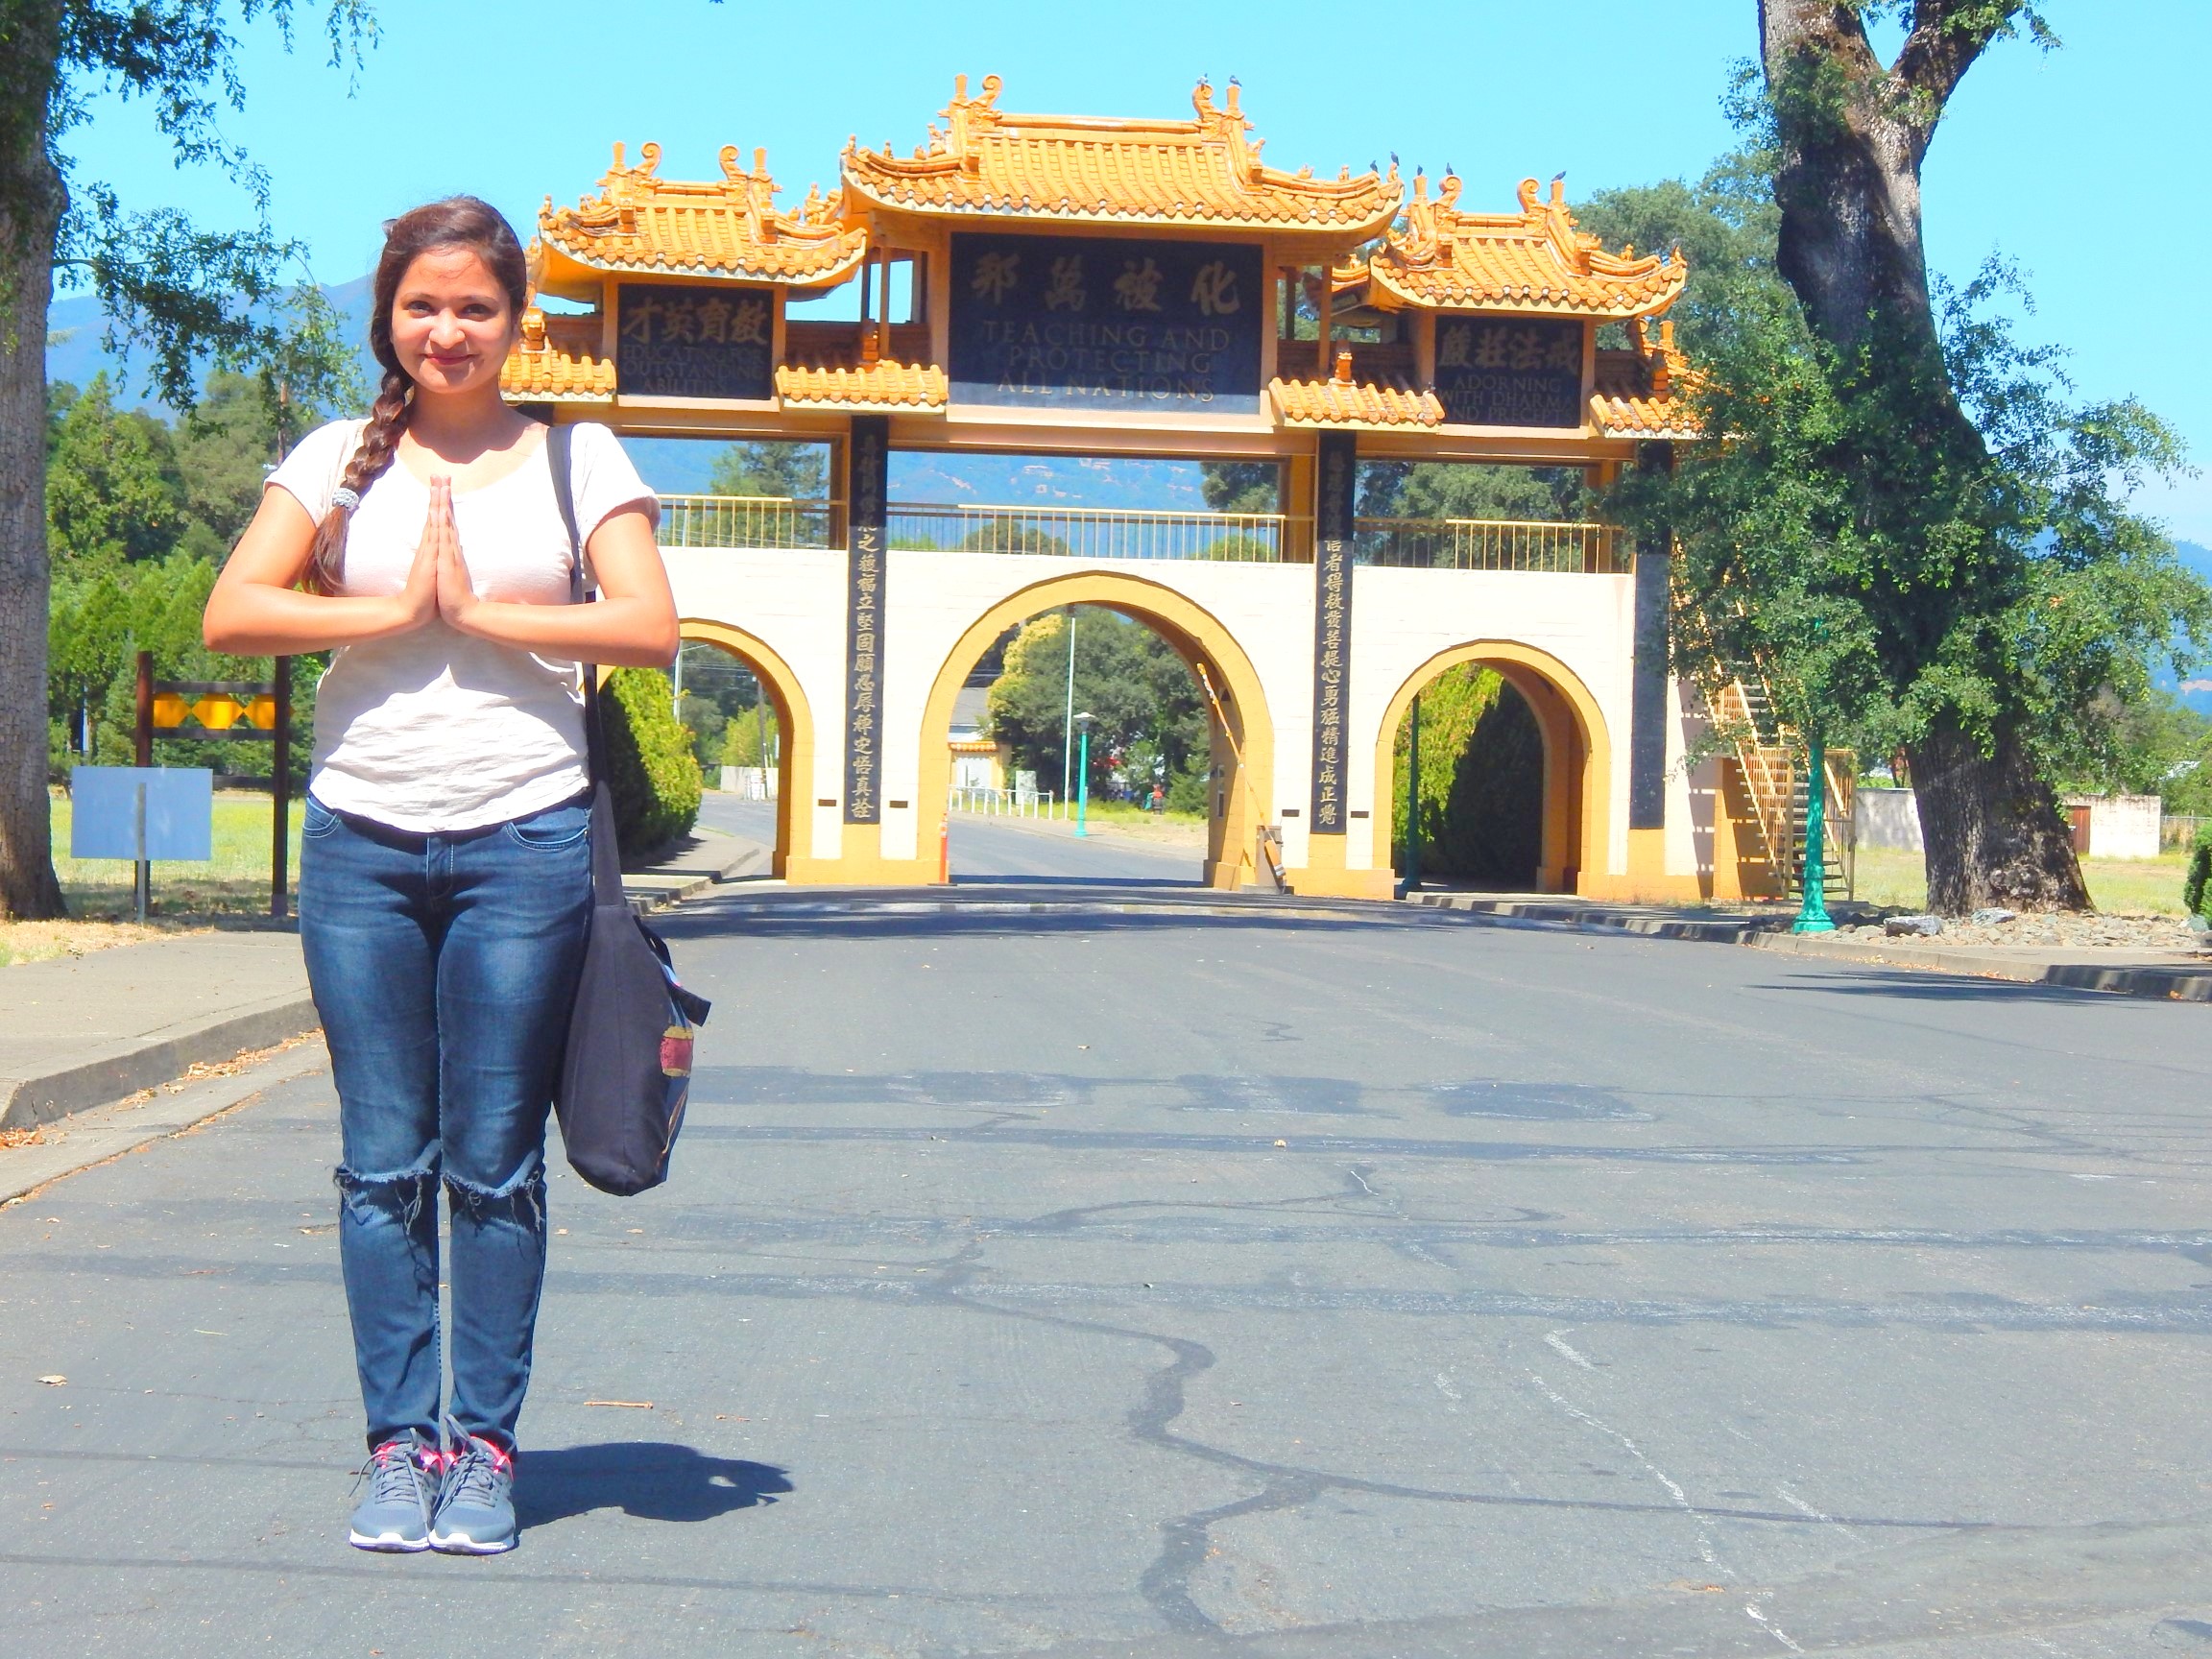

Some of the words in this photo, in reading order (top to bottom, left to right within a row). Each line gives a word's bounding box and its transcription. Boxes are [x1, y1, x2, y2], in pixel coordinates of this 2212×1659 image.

[984, 320, 1148, 349] TEACHING
[1160, 327, 1231, 352] AND
[623, 360, 764, 380] OUTSTANDING
[1008, 345, 1212, 374] PROTECTING
[997, 372, 1053, 396] ALL
[1066, 375, 1214, 401] NATIONS
[1454, 373, 1563, 394] ADORNING
[1438, 389, 1484, 406] WITH
[1491, 391, 1575, 410] DHARMA
[1487, 406, 1573, 425] PRECEPTS
